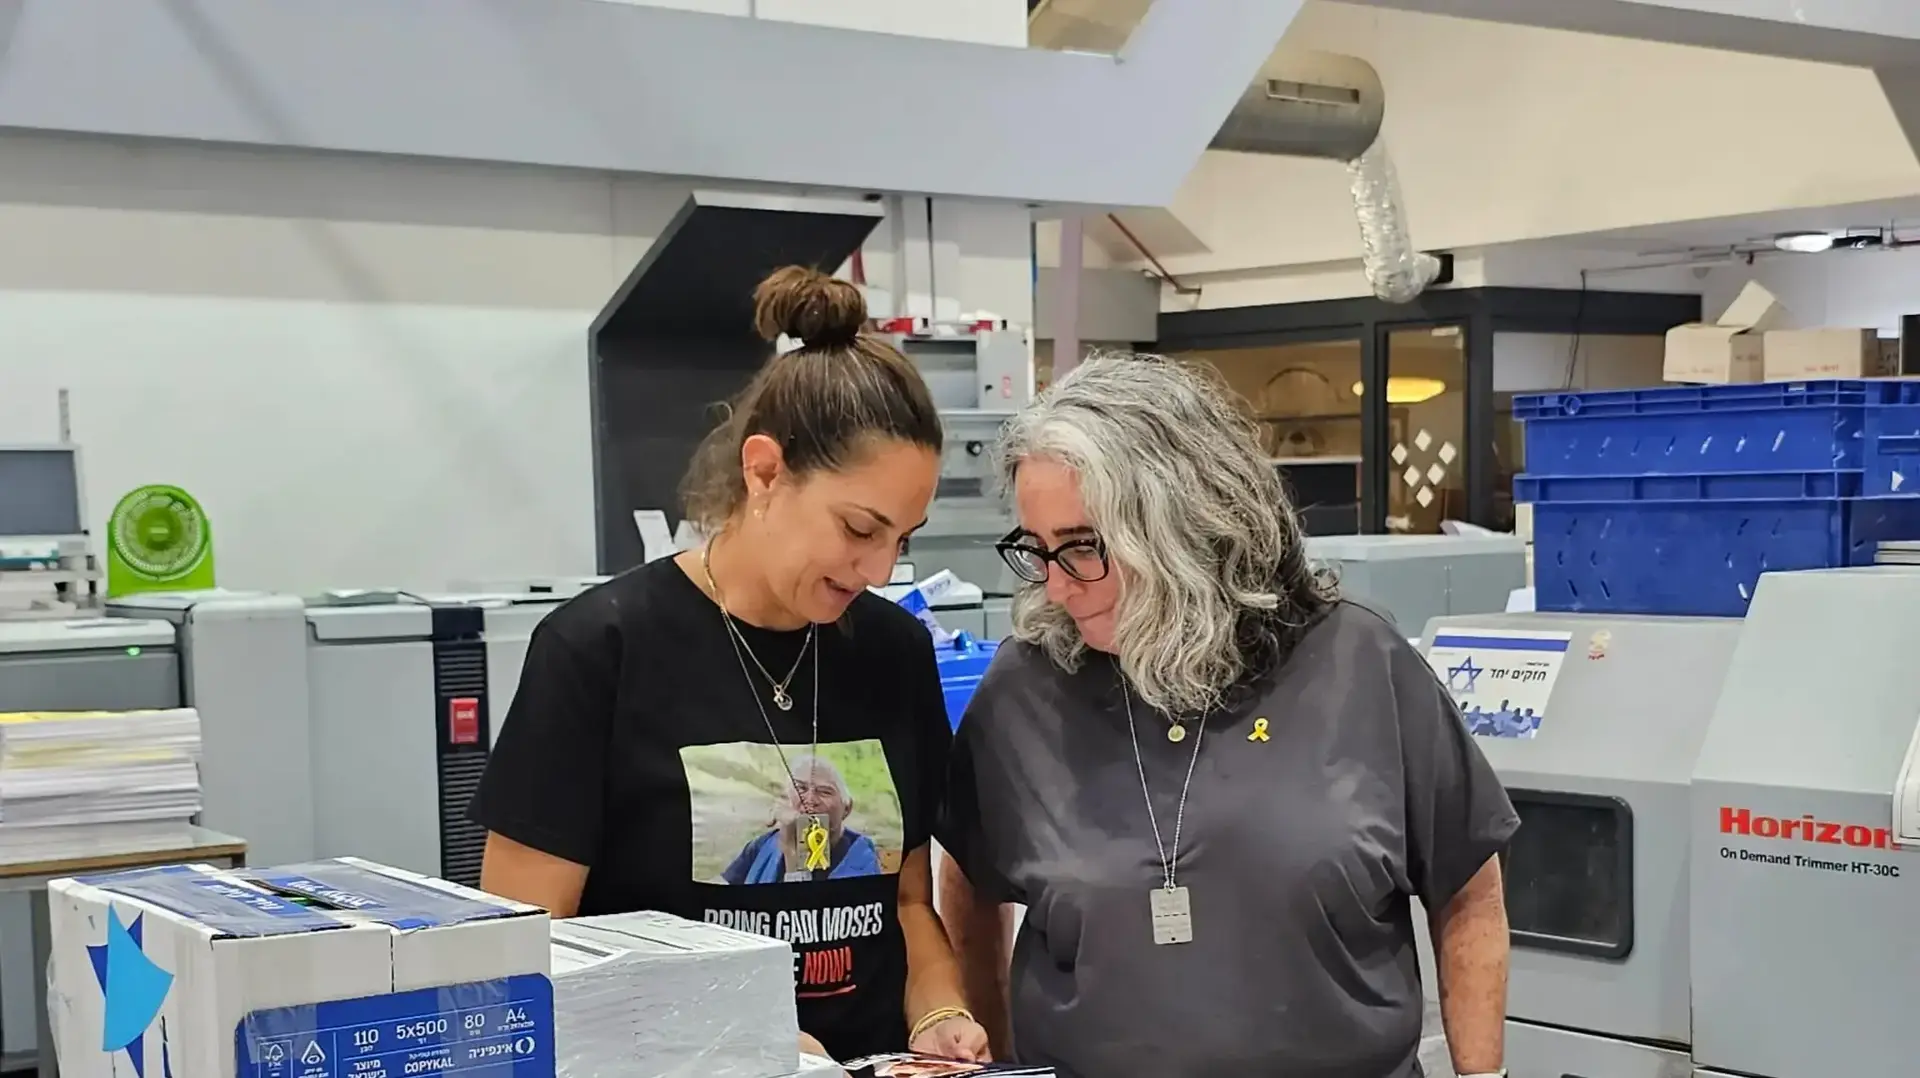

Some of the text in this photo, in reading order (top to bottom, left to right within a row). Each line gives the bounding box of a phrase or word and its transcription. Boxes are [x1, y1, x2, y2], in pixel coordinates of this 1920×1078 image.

[1490, 668, 1547, 682] חזקים יחד
[1720, 847, 1900, 878] On Demand Trimmer HT-30C
[775, 909, 820, 944] GADI
[822, 902, 883, 942] MOSES
[802, 946, 852, 984] NOW!
[464, 1013, 485, 1030] 80
[505, 1007, 527, 1023] A4
[353, 1028, 379, 1046] 110
[396, 1018, 448, 1040] 5x500
[468, 1042, 514, 1059] אינפיניה
[352, 1059, 381, 1071] מיוצר
[404, 1056, 456, 1074] COPYKAL
